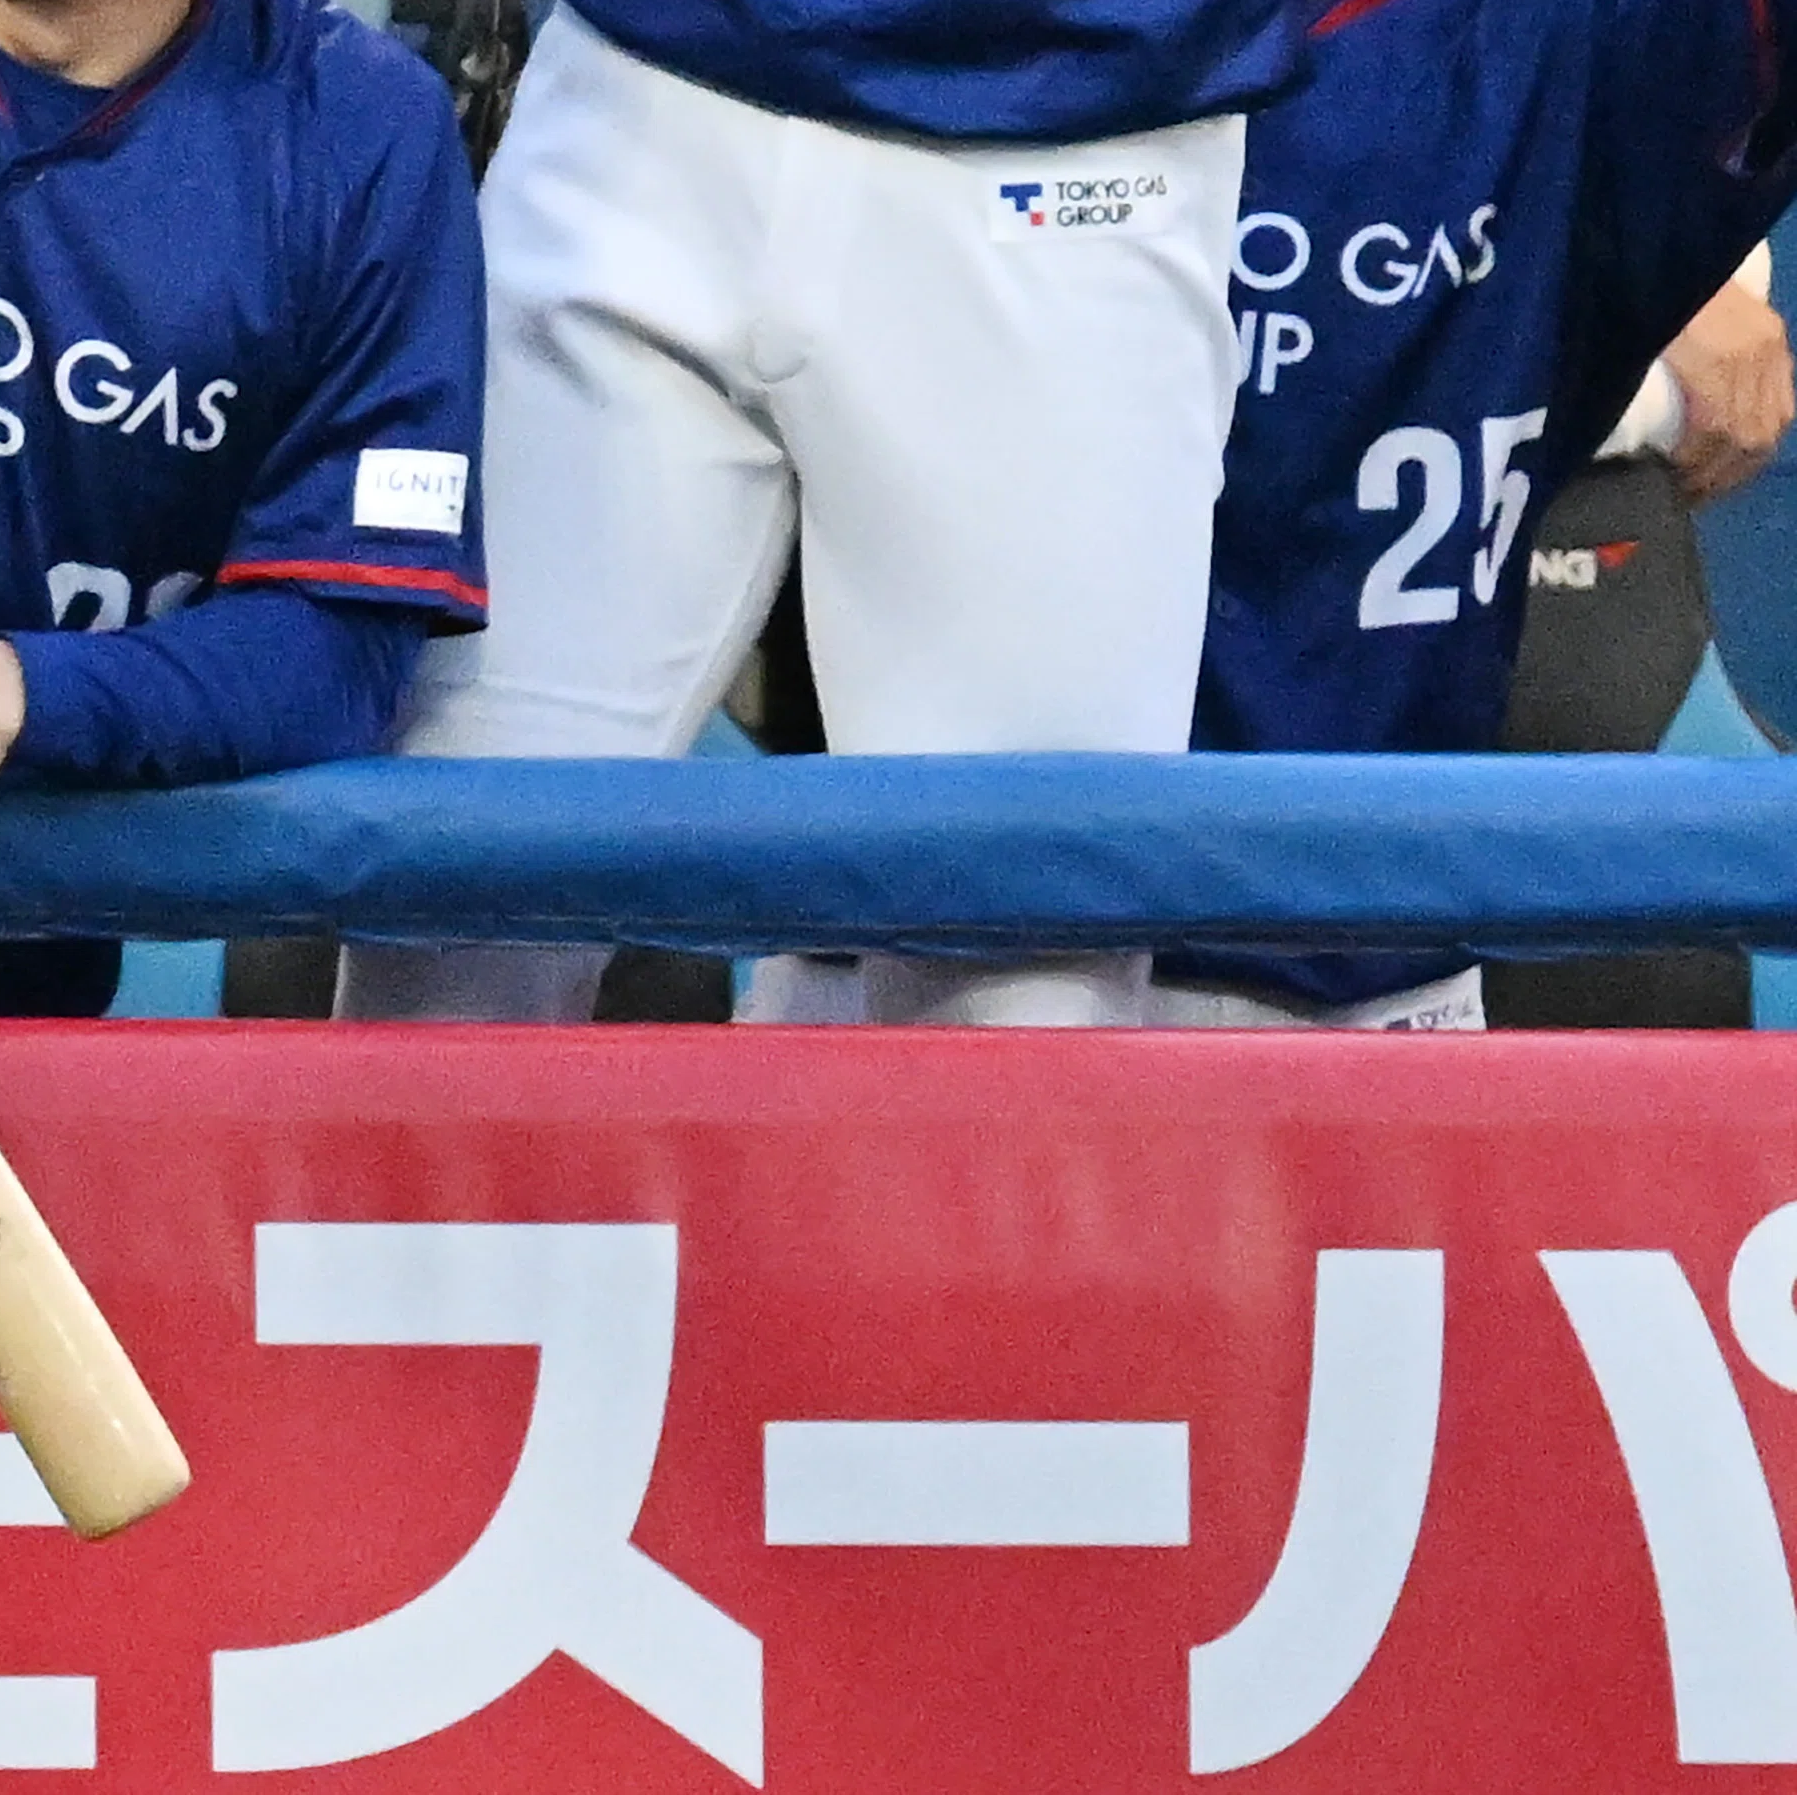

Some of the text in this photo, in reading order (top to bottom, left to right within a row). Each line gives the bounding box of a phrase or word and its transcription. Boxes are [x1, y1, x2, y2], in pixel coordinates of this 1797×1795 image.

[1056, 178, 1131, 202] TOKYO
[1056, 202, 1134, 228] GROUP
[1340, 204, 1497, 305] GAS
[54, 338, 237, 452] GAS
[1357, 406, 1548, 631] 25
